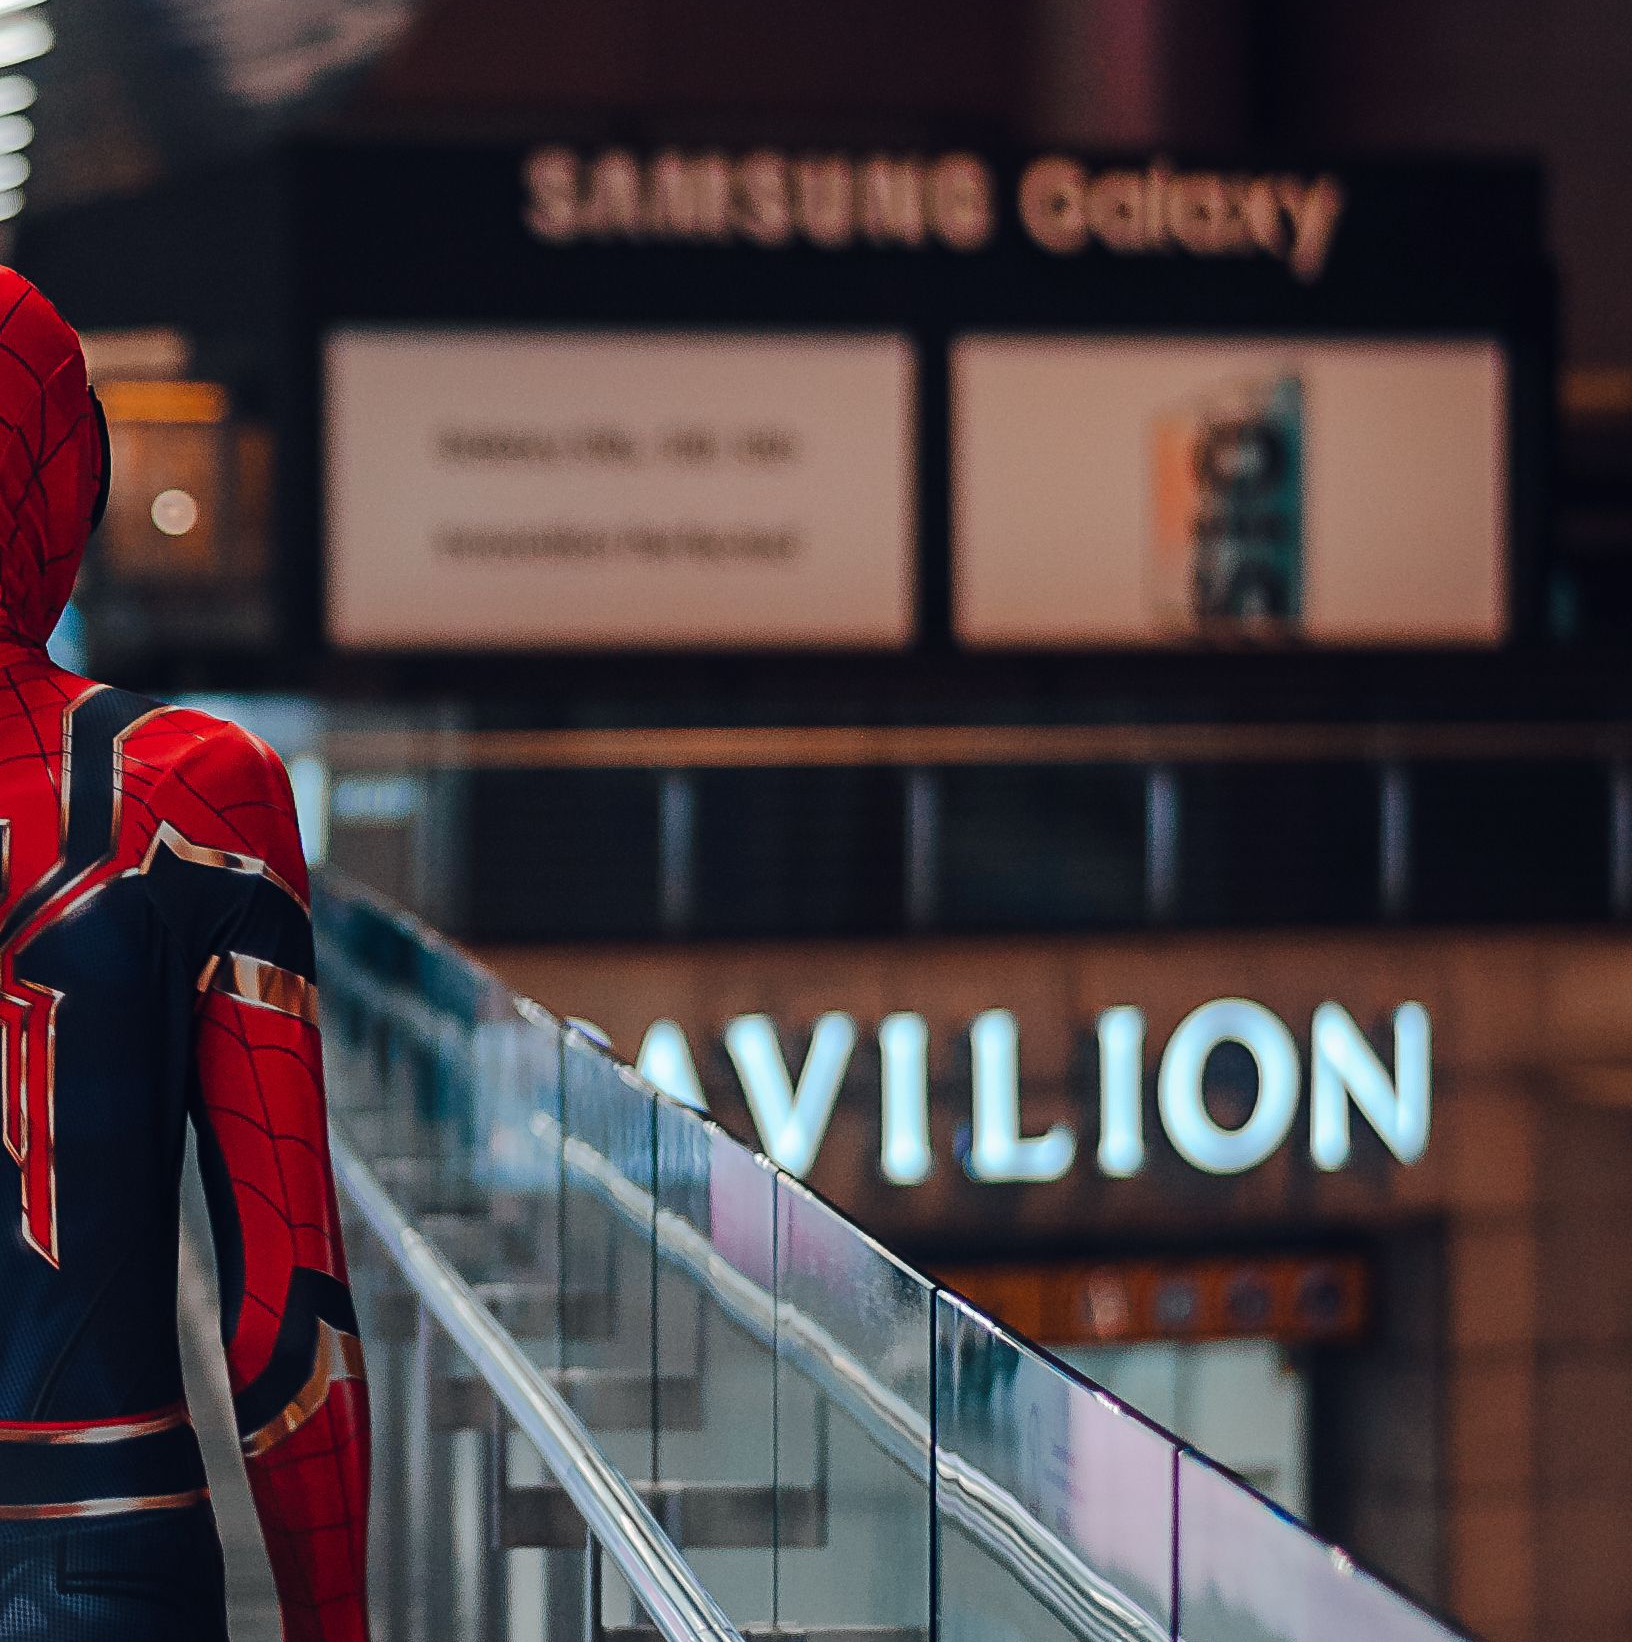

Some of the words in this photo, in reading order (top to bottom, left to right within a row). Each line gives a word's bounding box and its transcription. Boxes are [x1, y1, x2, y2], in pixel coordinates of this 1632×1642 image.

[524, 151, 992, 247] SAMSUNG
[1020, 157, 1340, 277] Galaxy
[566, 997, 1434, 1185] AVILION
